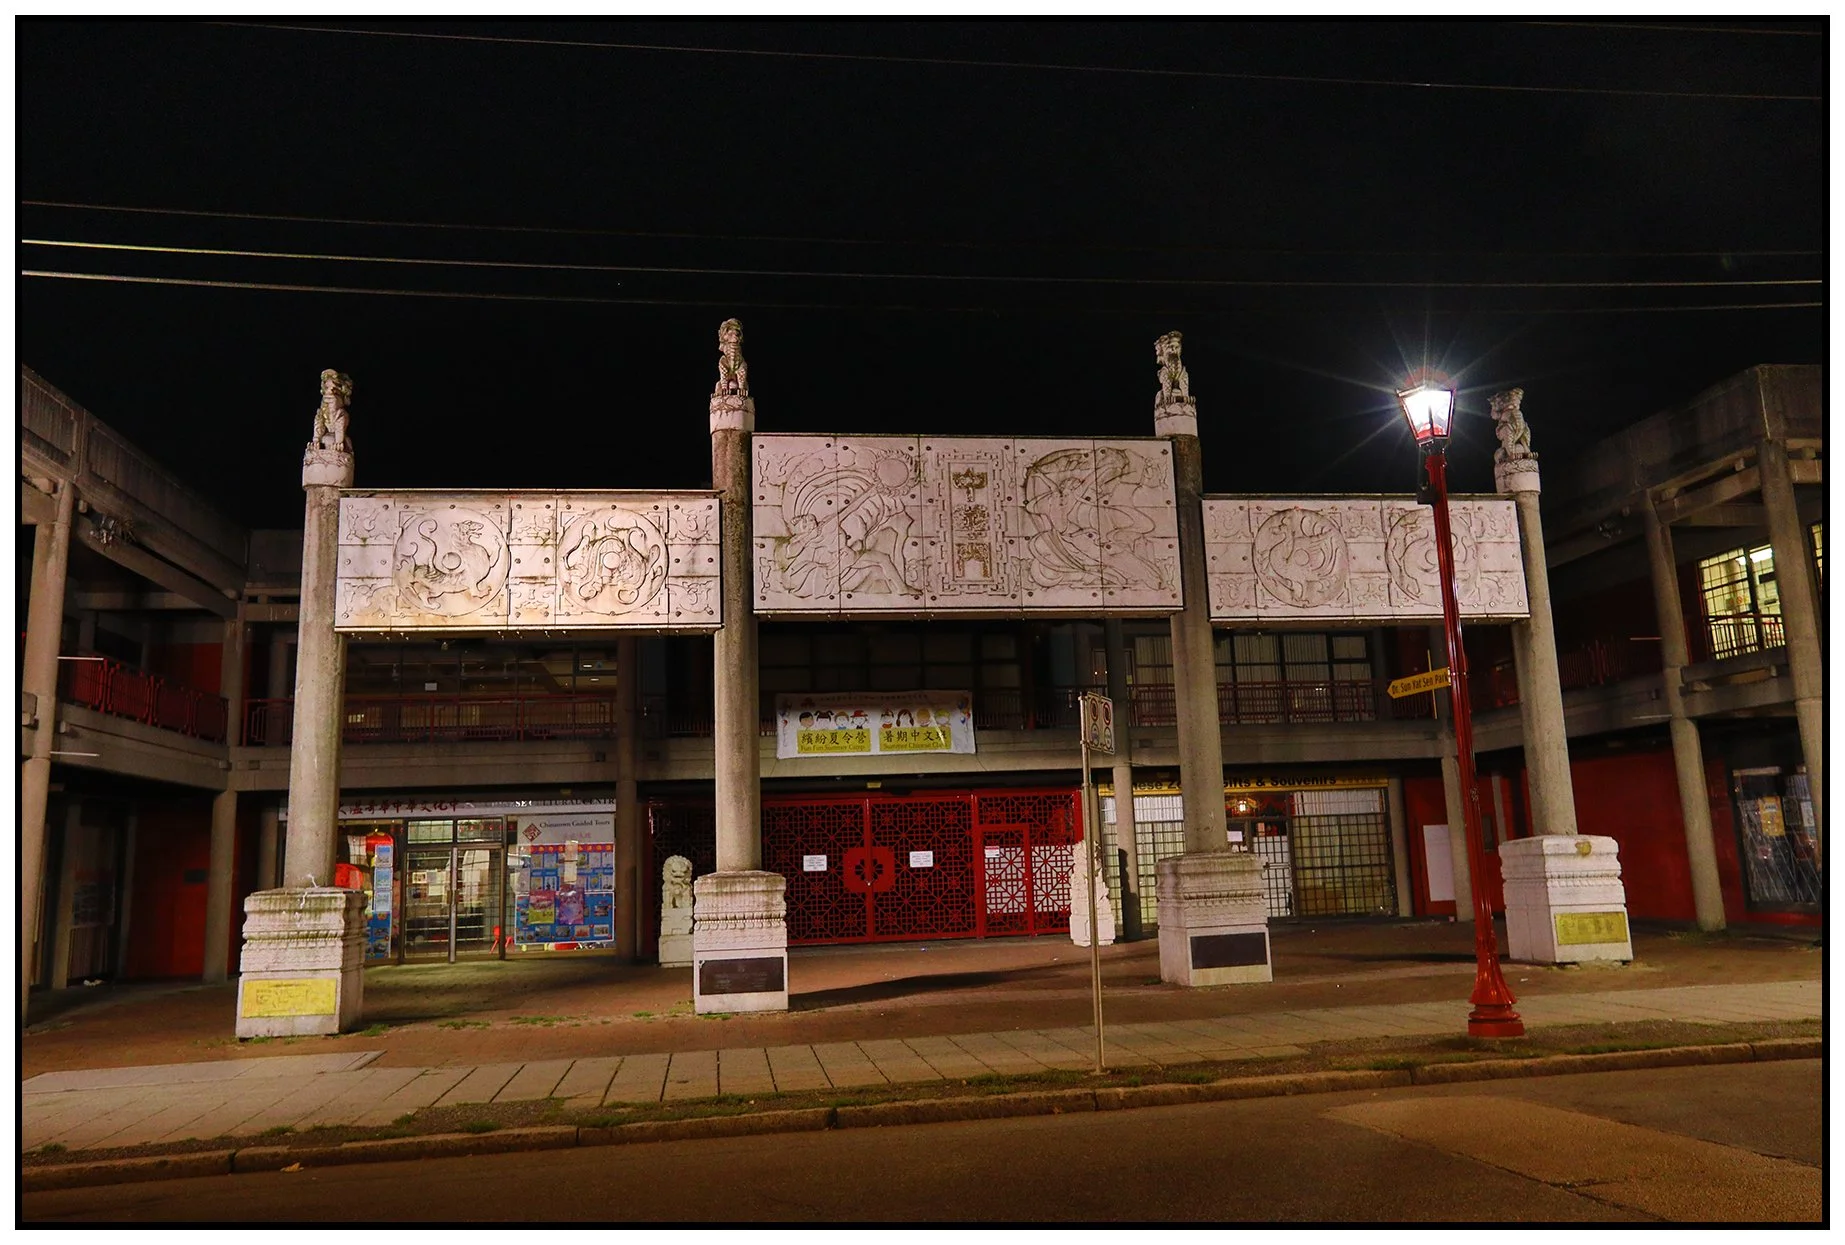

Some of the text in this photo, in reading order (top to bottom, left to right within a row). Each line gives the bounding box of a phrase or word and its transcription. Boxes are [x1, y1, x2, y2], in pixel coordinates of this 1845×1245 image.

[1391, 671, 1449, 695] Dr. Sun Yat Sen Park
[1256, 777, 1265, 786] &
[1270, 775, 1337, 786] Souvenirs
